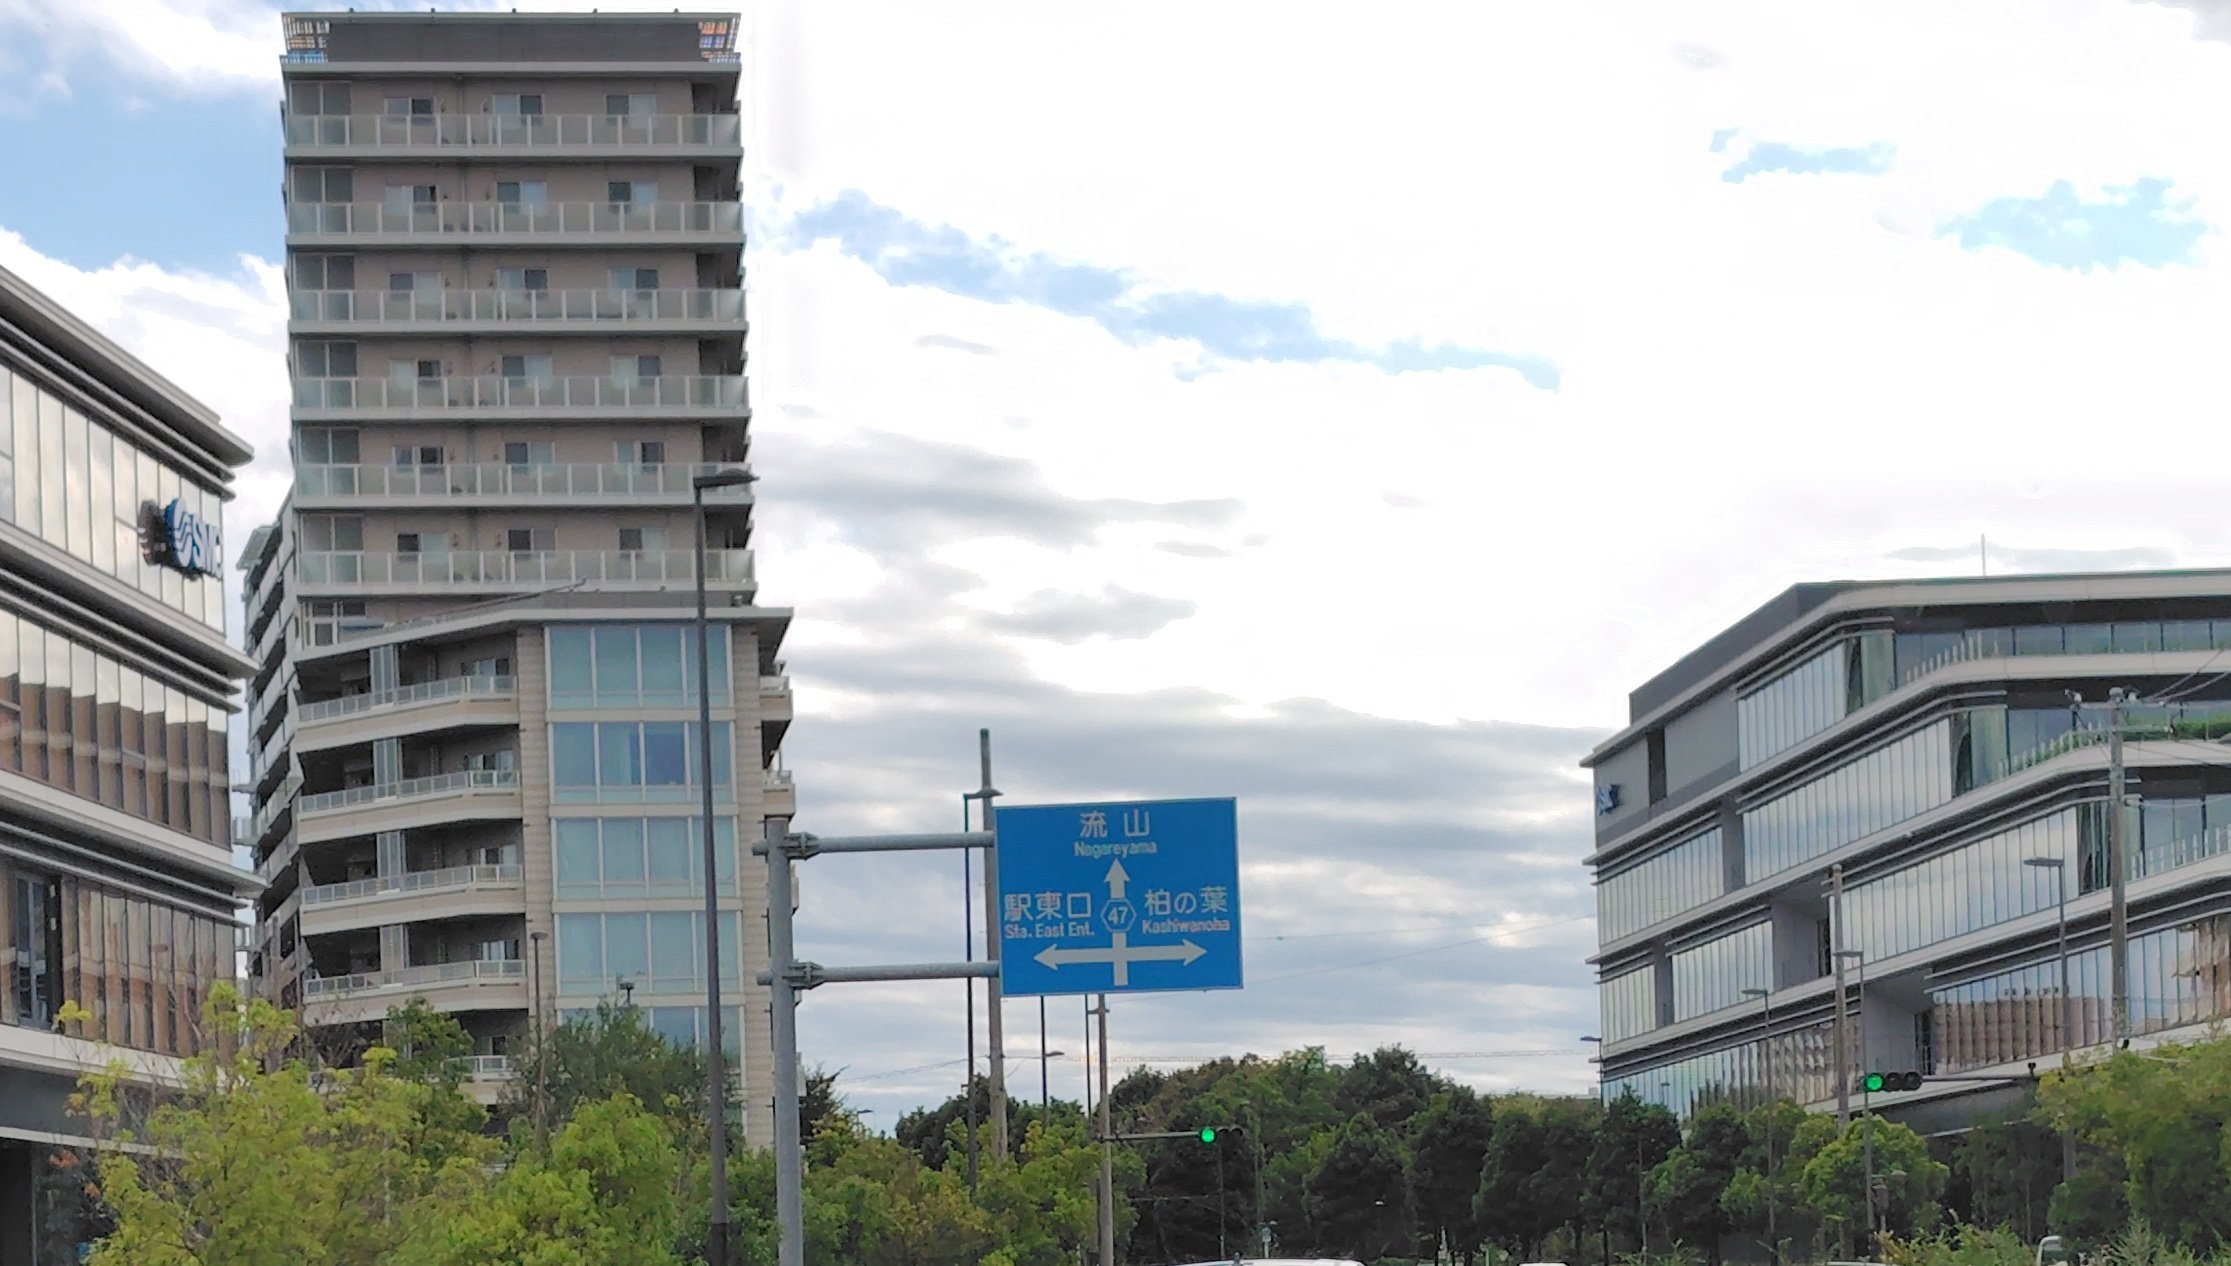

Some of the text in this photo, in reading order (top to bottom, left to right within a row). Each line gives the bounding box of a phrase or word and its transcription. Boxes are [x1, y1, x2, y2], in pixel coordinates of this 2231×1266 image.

[1079, 809, 1151, 838] 流山
[1074, 840, 1157, 859] Nagareyama
[1004, 891, 1092, 921] 駅東口
[1144, 886, 1228, 916] 柏の葉
[1107, 907, 1128, 924] 47
[1005, 922, 1095, 939] Sta. East Ent.
[1142, 917, 1230, 934] Kashiwanoha
